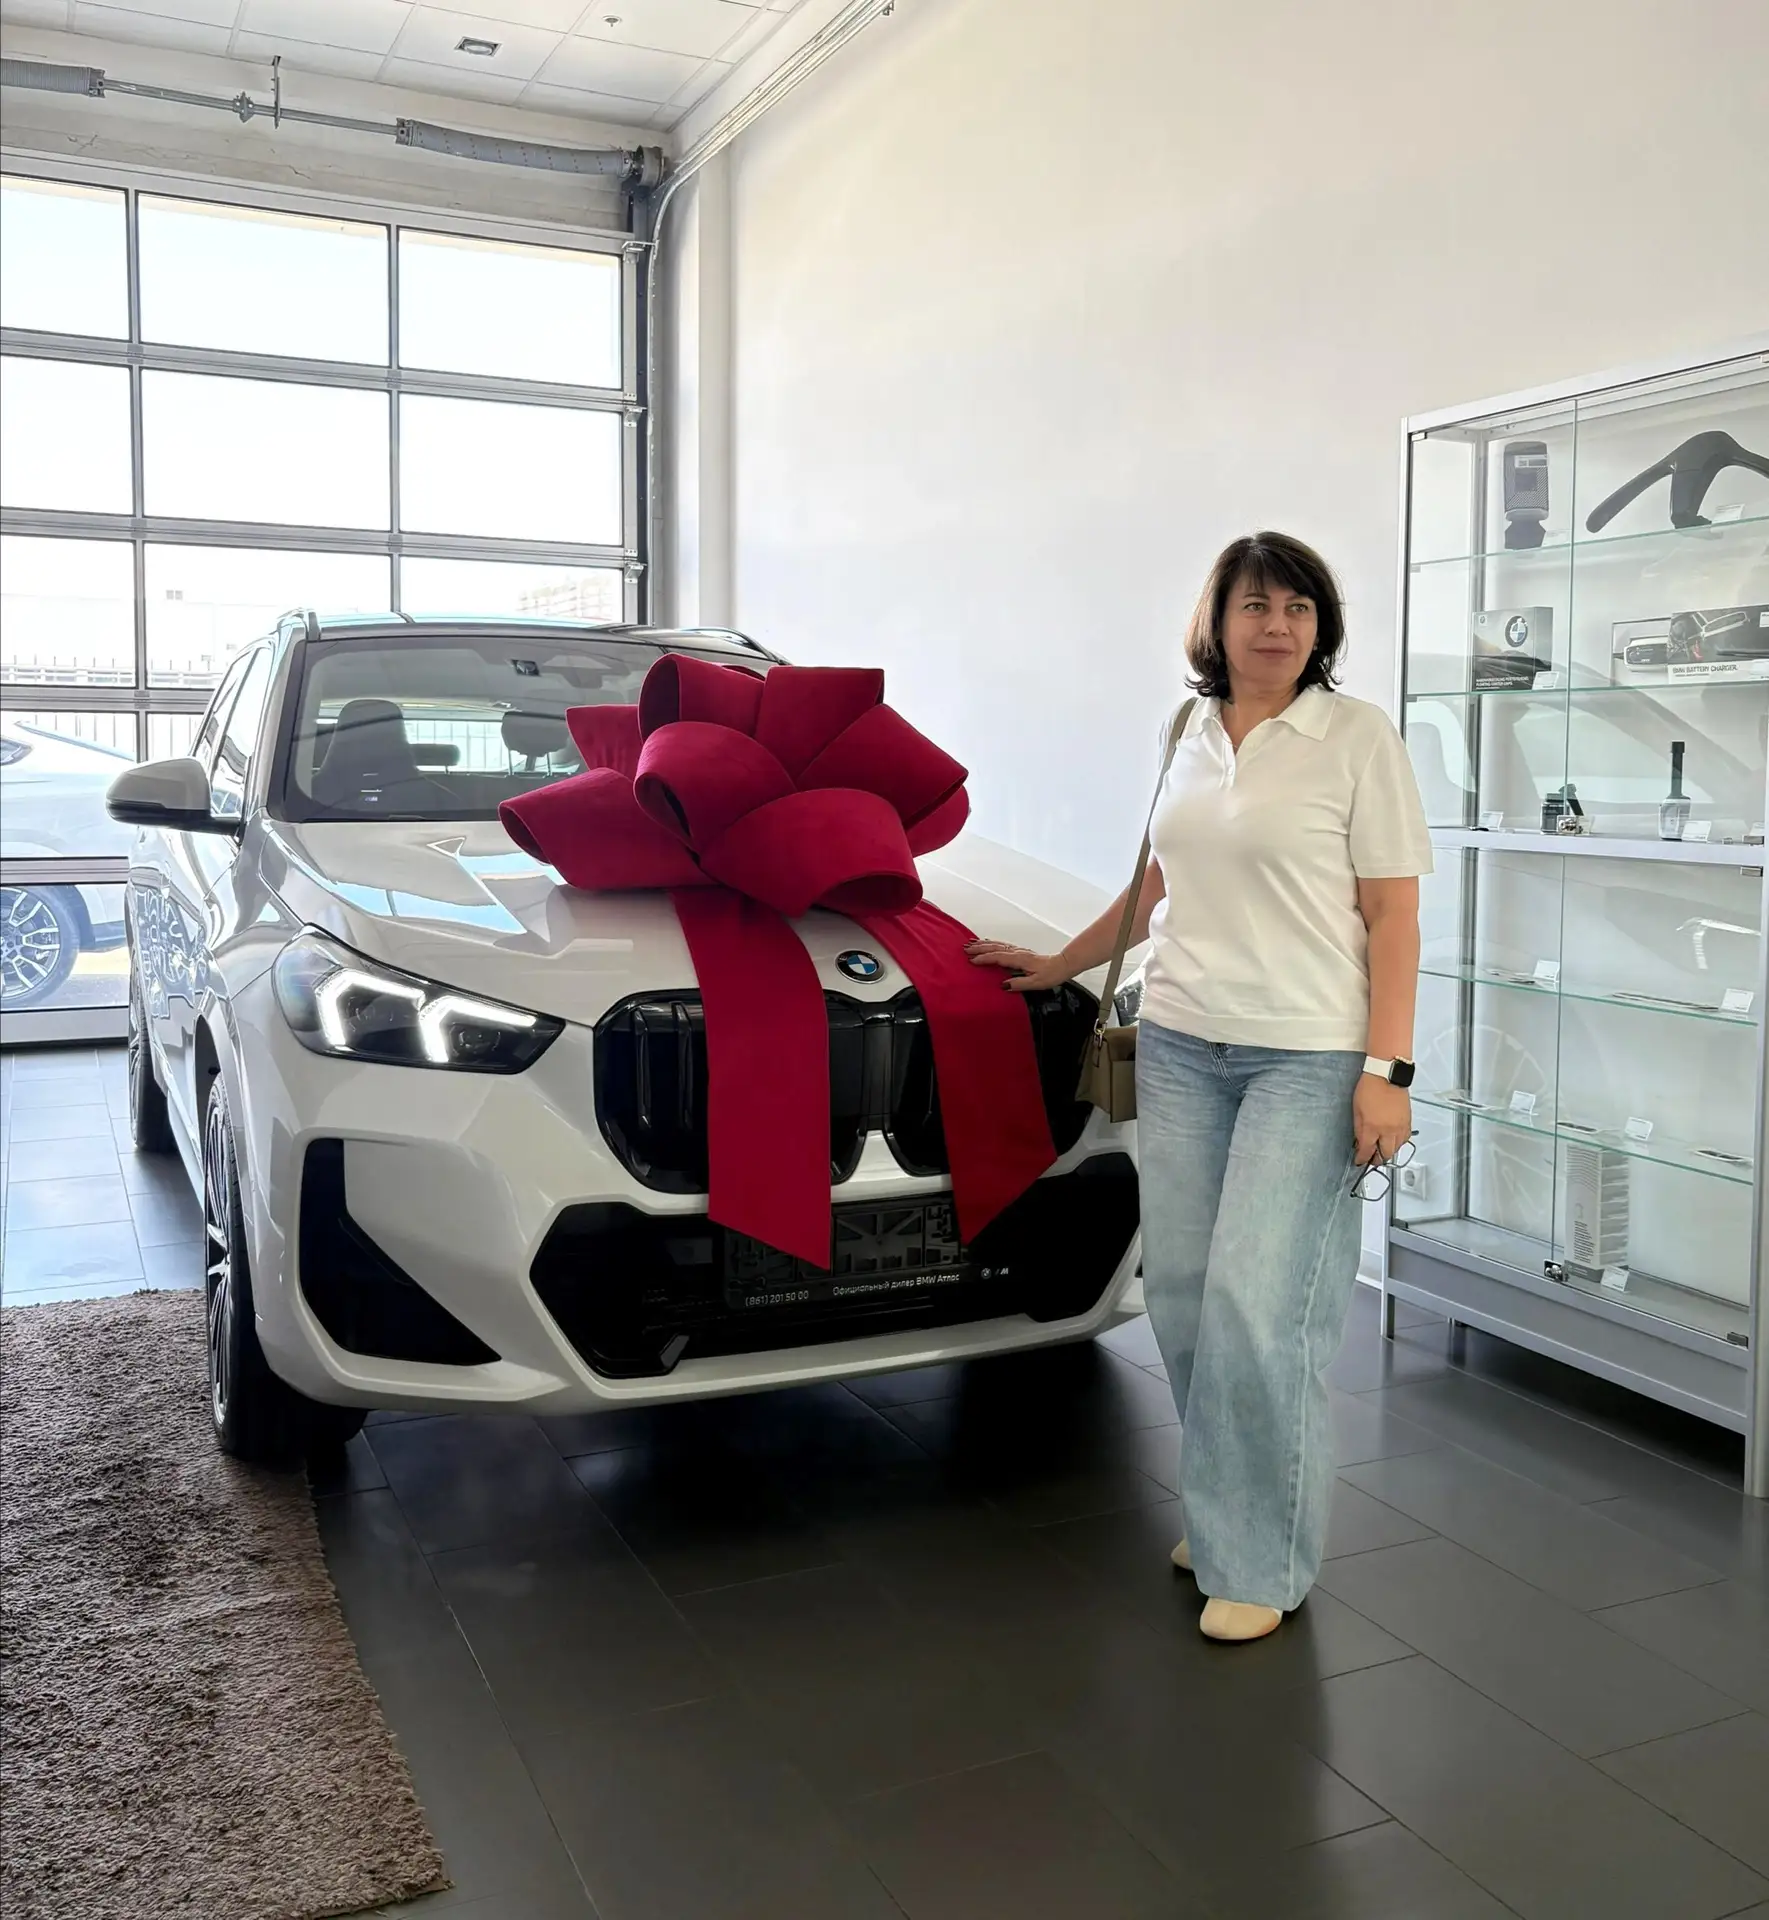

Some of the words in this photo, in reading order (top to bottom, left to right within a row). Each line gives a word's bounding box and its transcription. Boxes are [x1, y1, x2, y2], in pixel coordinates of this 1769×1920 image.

[1686, 665, 1709, 673] BATTERY
[832, 1281, 890, 1296] Официальный
[891, 1279, 914, 1290] дилер
[916, 1275, 936, 1286] BMW
[745, 1294, 768, 1307] (861)
[769, 1293, 784, 1304] 201
[785, 1292, 796, 1302] 50
[797, 1290, 809, 1300] 00
